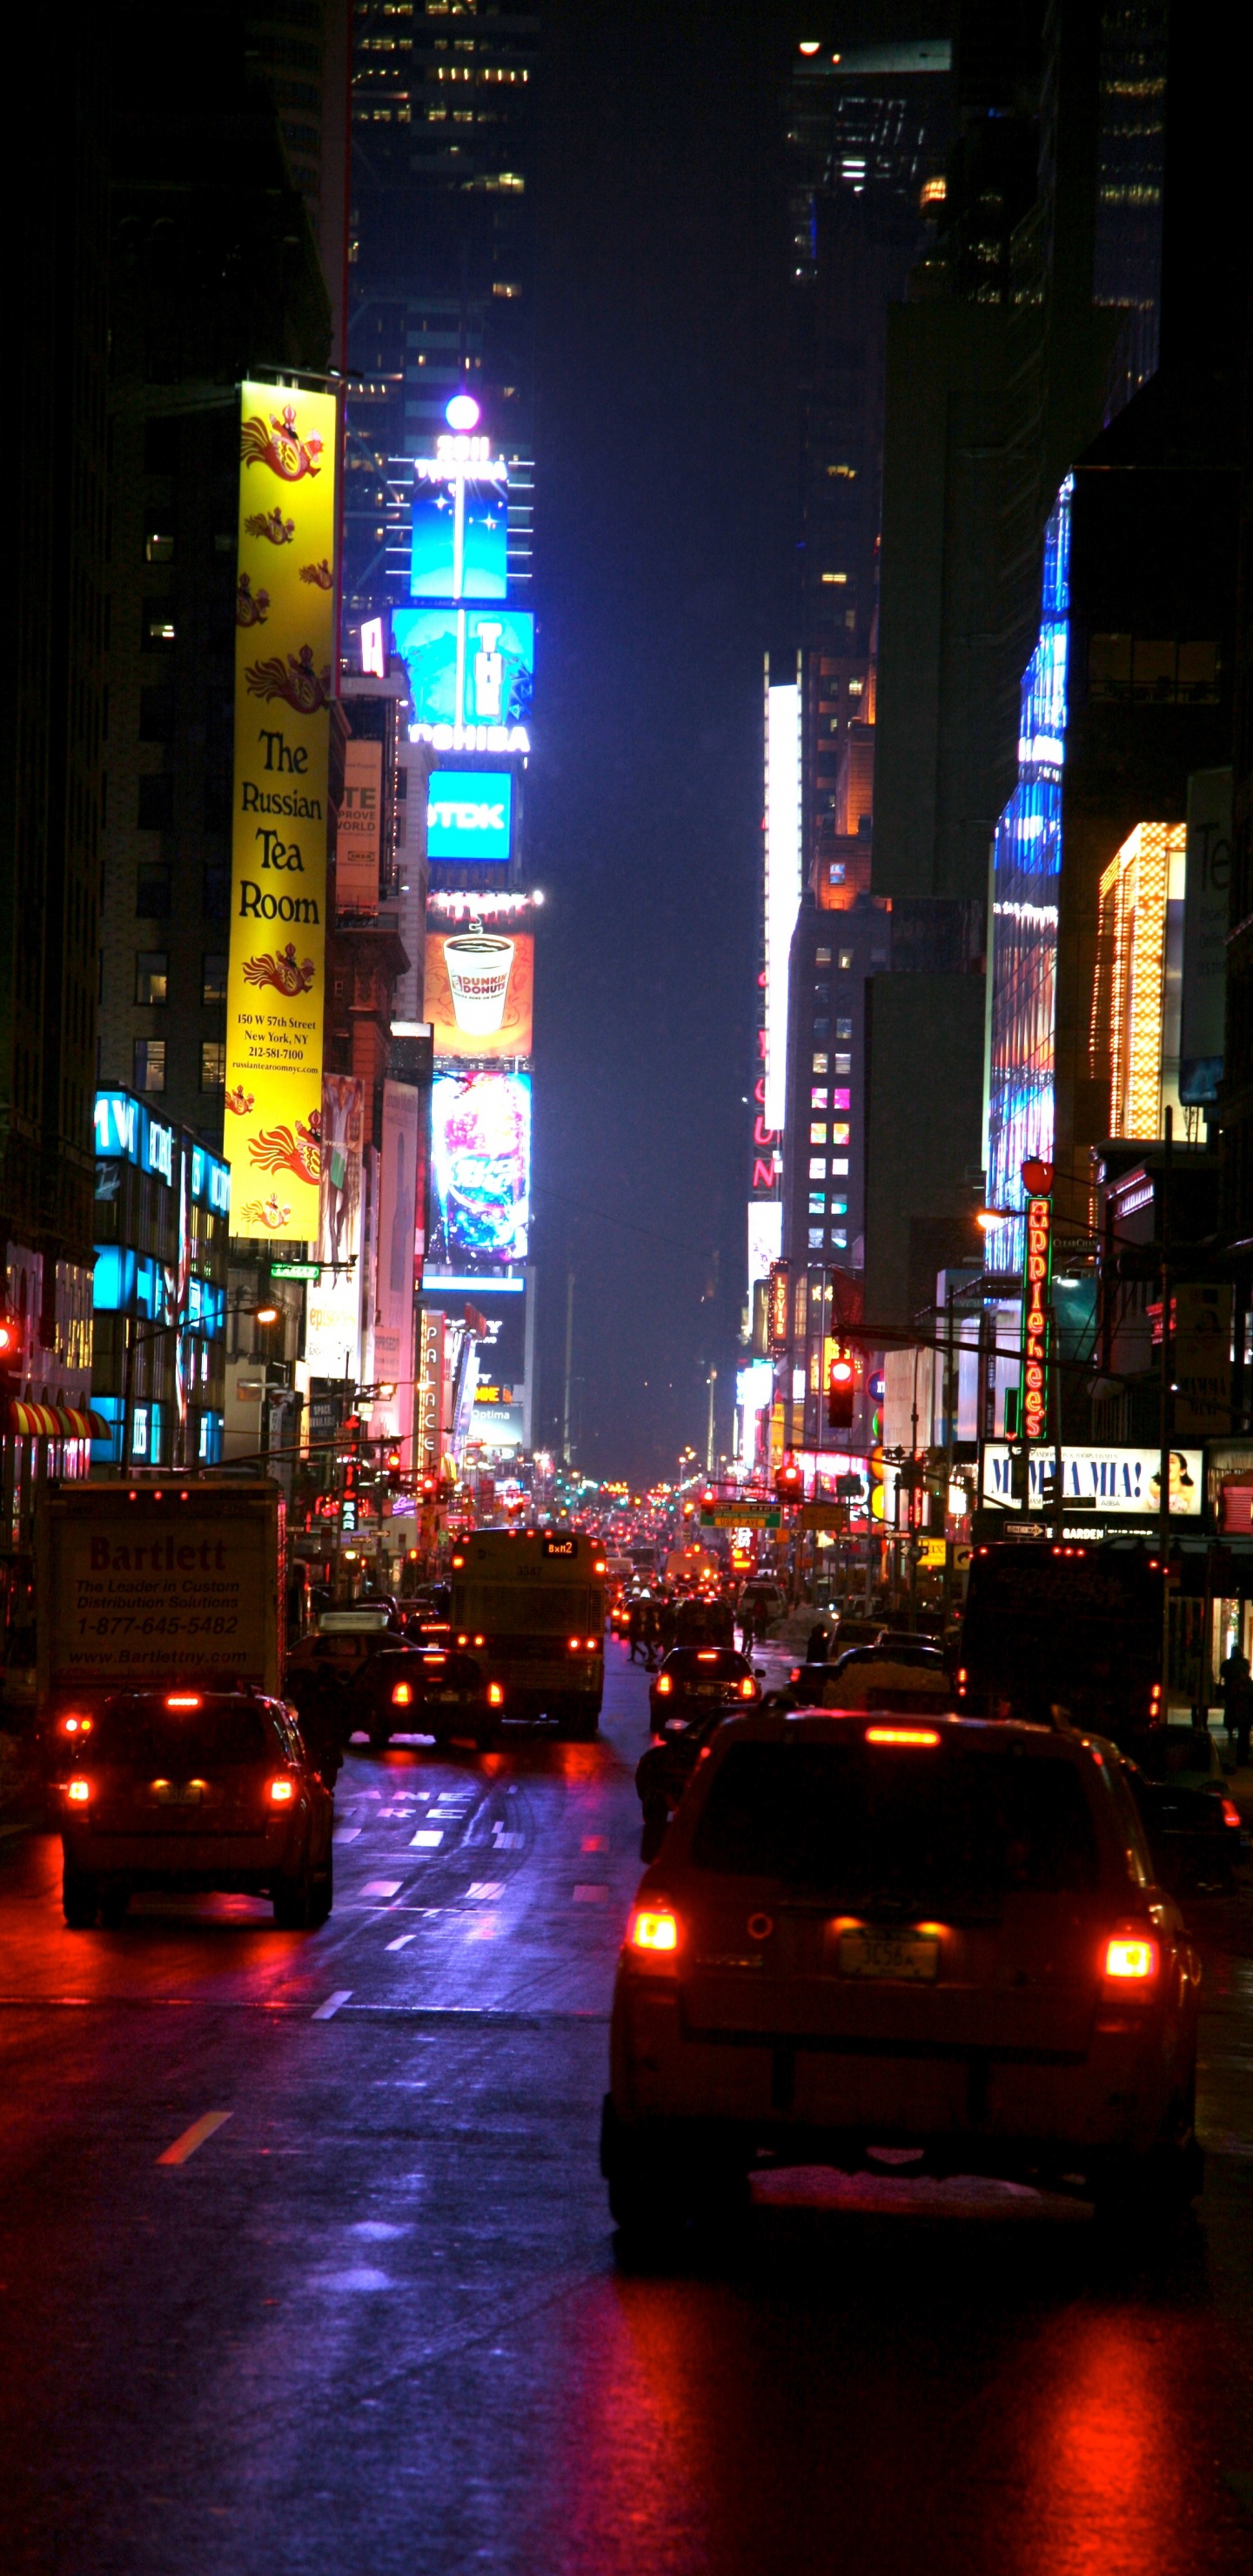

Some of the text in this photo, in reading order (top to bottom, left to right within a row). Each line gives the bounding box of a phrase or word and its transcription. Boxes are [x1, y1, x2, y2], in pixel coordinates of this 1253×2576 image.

[409, 722, 531, 753] OSHIBA
[258, 729, 308, 775] The
[241, 781, 323, 821] Russian
[256, 827, 305, 873] Tea
[238, 879, 320, 925] Room
[463, 983, 506, 994] DONUTS
[238, 1015, 316, 1030] 150 W 57th Street
[245, 1030, 309, 1045] New York, NY
[249, 1047, 304, 1060] 212-581-7100
[232, 1062, 318, 1073] russiantearoomnyc.com
[424, 1326, 437, 1451] PALACE
[313, 1405, 332, 1416] SPACE
[472, 1409, 510, 1421] Optima
[991, 1459, 1142, 1498] MMMA MIA!
[342, 1501, 355, 1530] BAR
[1062, 1527, 1104, 1540] GARDEN
[90, 1536, 227, 1571] Bartlett
[548, 1541, 573, 1554] BxM2
[76, 1580, 240, 1593] The Leader in Custom
[77, 1596, 238, 1609] Distribution Solutions
[78, 1616, 238, 1635] 1-877-645-5482
[69, 1650, 247, 1666] www.Bartlettny.com
[346, 1791, 475, 1801] ANE
